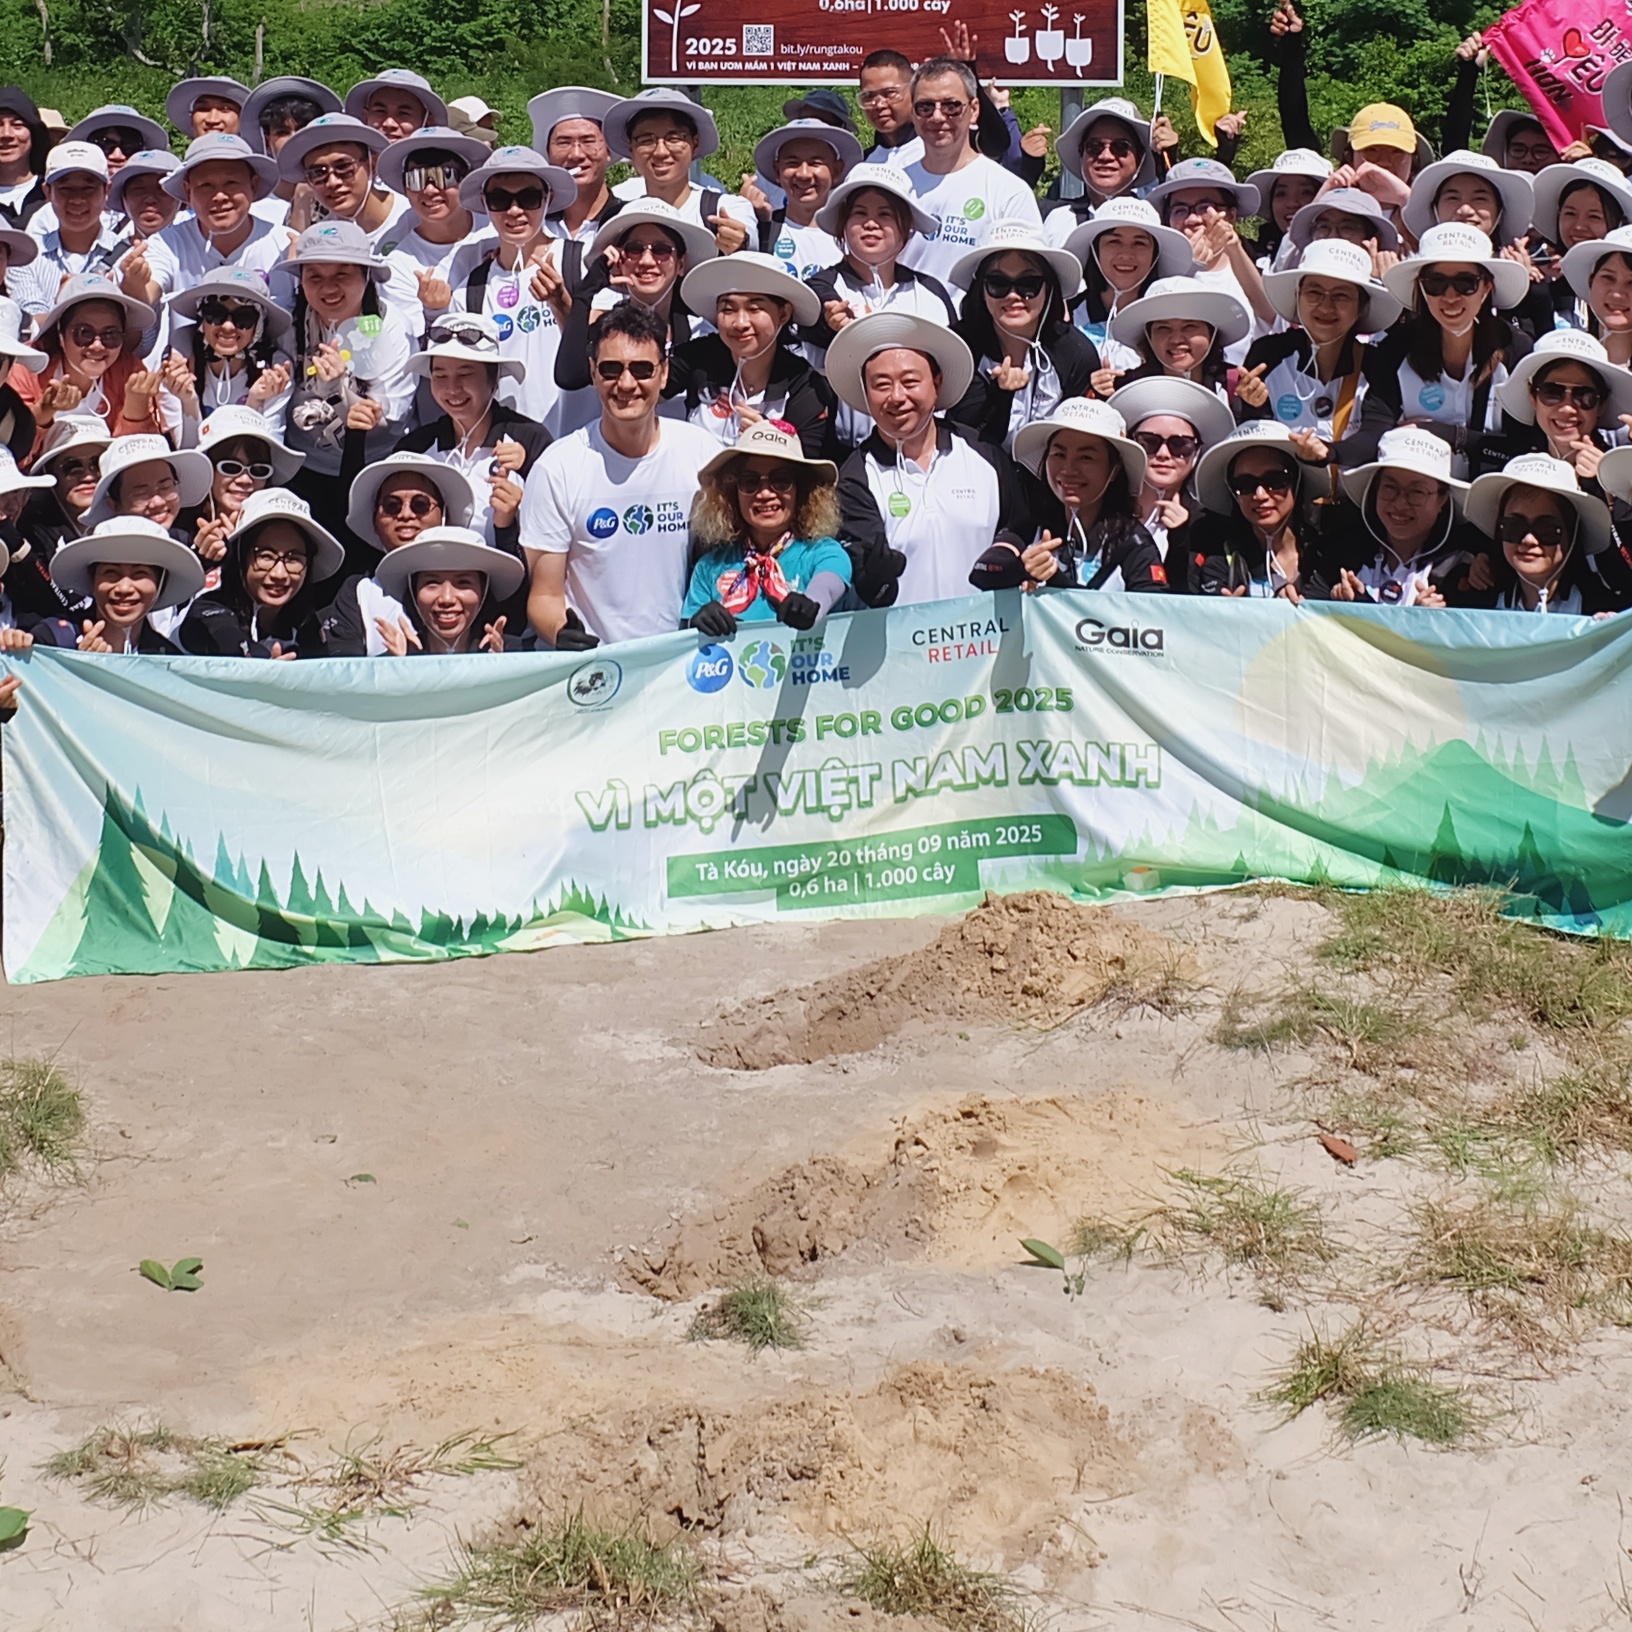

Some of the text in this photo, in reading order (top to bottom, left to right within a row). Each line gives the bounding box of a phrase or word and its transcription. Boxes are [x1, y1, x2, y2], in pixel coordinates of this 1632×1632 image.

[685, 38, 737, 55] 2025
[780, 44, 863, 56] bit.ly/rungtakou
[770, 62, 774, 70] 1
[799, 62, 820, 70] NAM
[822, 62, 850, 70] XANH
[1112, 205, 1150, 216] CENTRAL
[945, 216, 966, 224] IT'S
[944, 226, 968, 235] OUR
[943, 236, 975, 246] HOME
[1436, 234, 1475, 245] CENTRAL
[1328, 248, 1364, 266] CENTRAL
[751, 431, 786, 445] Gaia
[1404, 438, 1448, 457] CENTRAL
[657, 503, 678, 512] IT'S
[592, 515, 614, 530] P&G
[657, 514, 683, 522] OUR
[912, 617, 1009, 646] CENTRAL
[1075, 618, 1164, 650] Gaia
[791, 637, 825, 653] IT'S
[928, 640, 998, 663] RETAIL
[1075, 645, 1165, 657] NATURE CONSERVATION
[791, 653, 833, 668] OUR
[695, 658, 729, 679] P&G
[792, 667, 850, 686] HOME
[659, 687, 1075, 755] FORESTS FOR GOOD 2025
[575, 740, 1161, 834] VÌ MỘT VIỆT NAM XANH
[696, 825, 1042, 881] Tà Kóu, ngày 20 tháng 09 năm 2025
[789, 881, 818, 898] 0,6
[824, 876, 848, 893] ha
[865, 866, 918, 889] 1.000
[922, 862, 956, 884] cây
